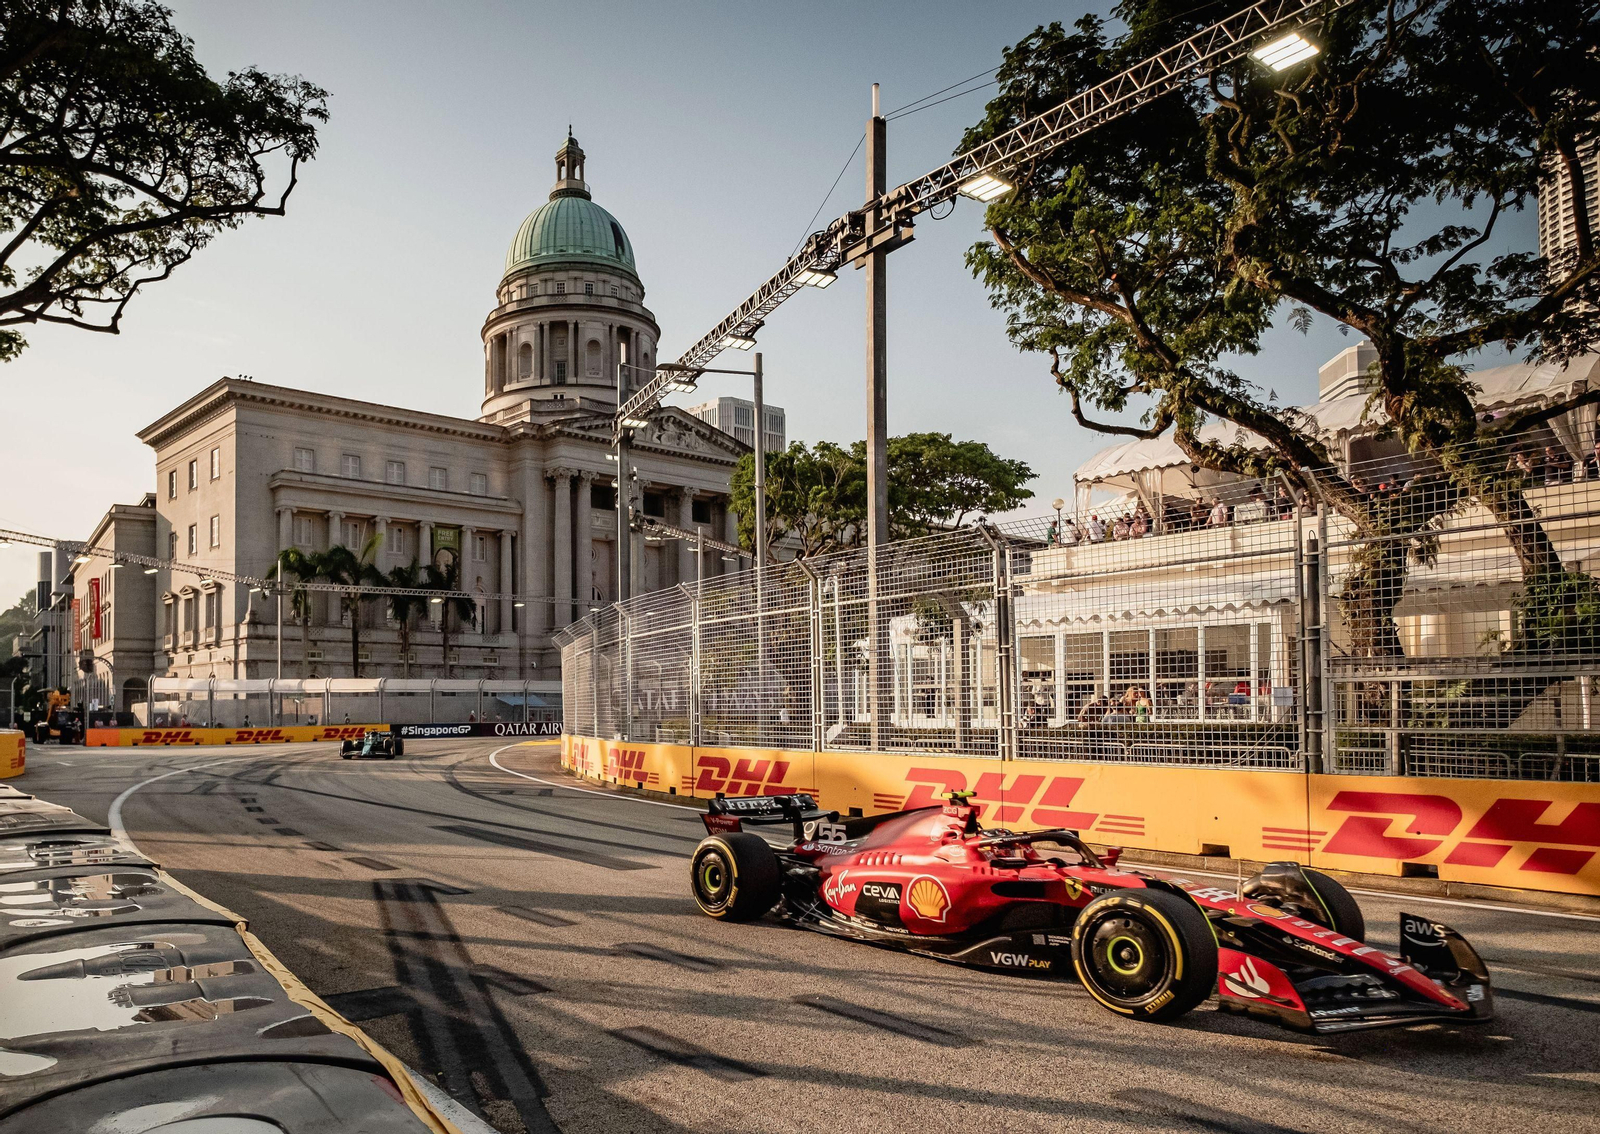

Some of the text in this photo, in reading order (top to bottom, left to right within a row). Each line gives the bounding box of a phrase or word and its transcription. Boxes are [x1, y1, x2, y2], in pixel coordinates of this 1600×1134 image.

[142, 731, 195, 743] DHL
[235, 729, 286, 742] DHL
[323, 727, 366, 739] DHL
[401, 725, 471, 736] #SingaporeGP
[495, 723, 537, 736] QATAR
[573, 743, 590, 770] DHL
[608, 748, 649, 782] DHL
[695, 755, 797, 796] DHL
[901, 767, 1100, 830] DHL
[710, 816, 734, 826] V-Power
[818, 823, 847, 845] 55
[823, 869, 857, 906] Ray-Ban
[1404, 918, 1446, 938] aws
[990, 951, 1052, 969] VGW PLAY
[1292, 938, 1345, 964] Santander
